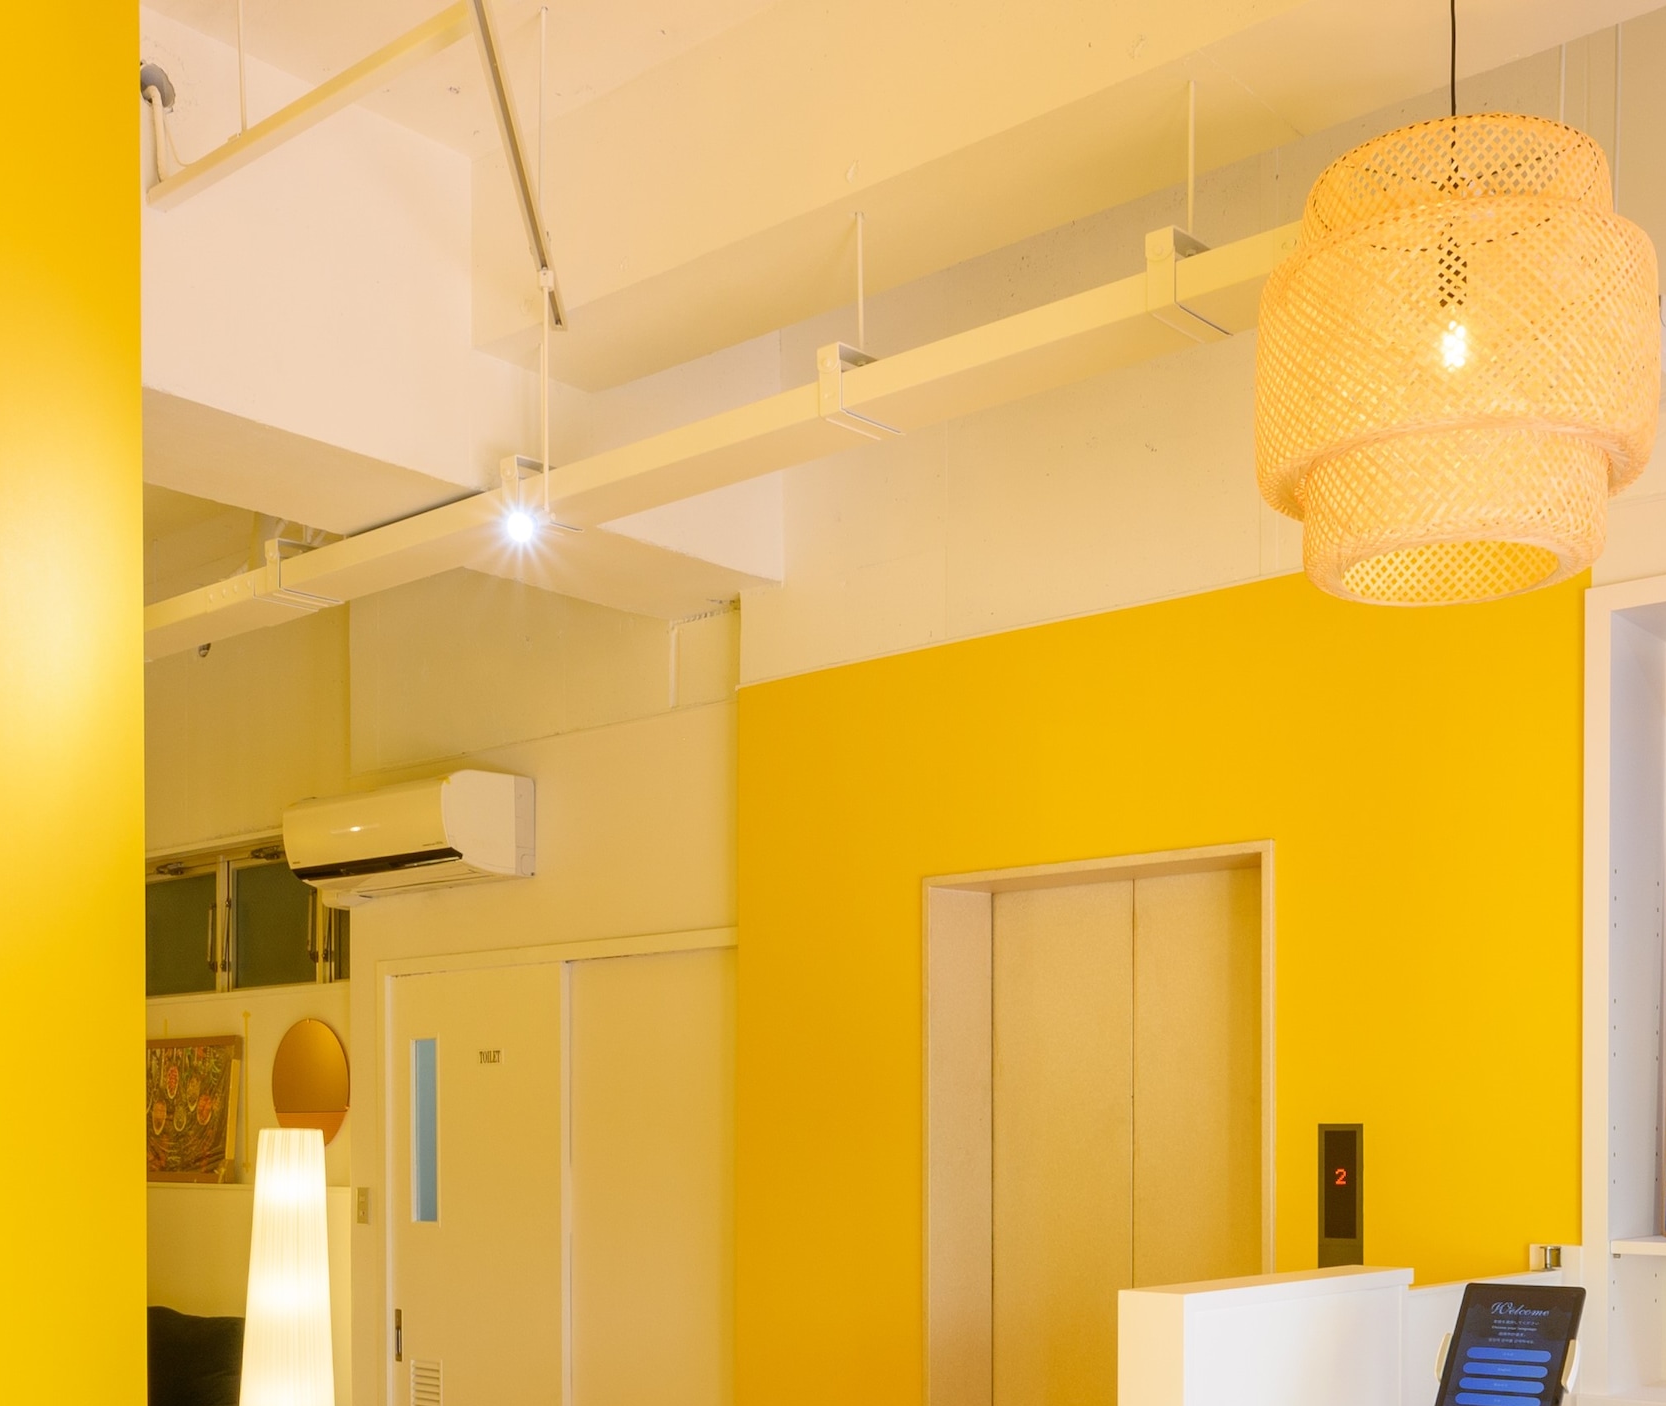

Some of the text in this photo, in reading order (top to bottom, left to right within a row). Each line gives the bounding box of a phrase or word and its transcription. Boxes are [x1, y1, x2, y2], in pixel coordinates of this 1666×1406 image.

[479, 1050, 501, 1064] TOILET
[1335, 1168, 1347, 1185] 2
[1491, 1302, 1550, 1317] Welcome
